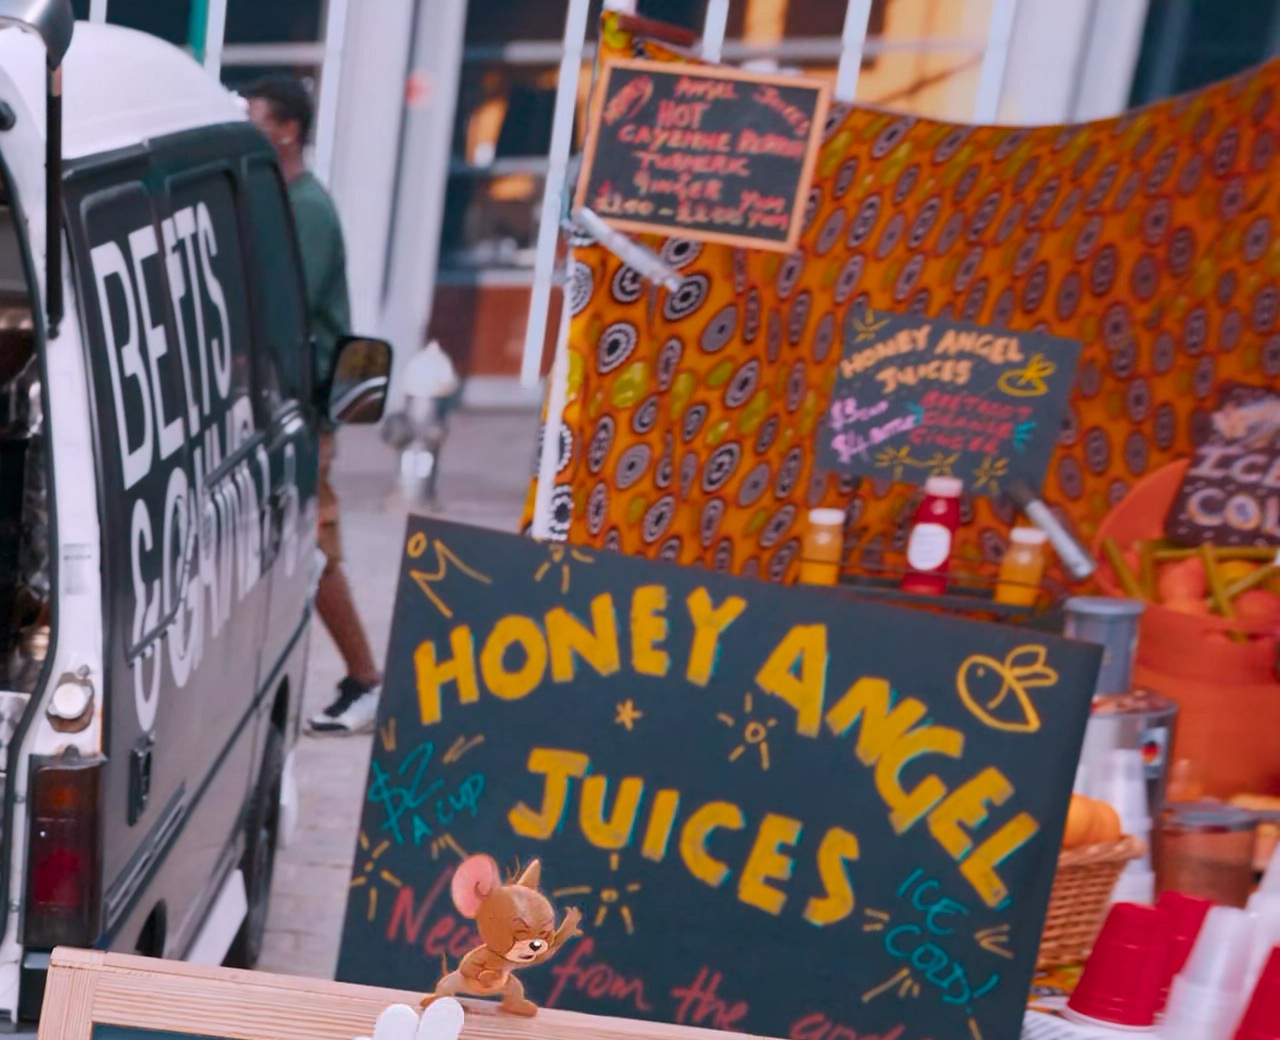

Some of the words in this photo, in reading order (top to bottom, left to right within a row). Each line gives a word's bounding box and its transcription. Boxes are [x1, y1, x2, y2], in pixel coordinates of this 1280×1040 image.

[656, 98, 711, 129] HOT
[840, 324, 932, 379] HONEY
[934, 329, 1024, 364] ANGEL
[412, 584, 747, 726] HONEY
[755, 623, 1040, 910] ANGEL
[507, 747, 861, 927] JUICES
[895, 866, 970, 936] ICE
[546, 936, 648, 1010] from
[672, 965, 750, 1032] the
